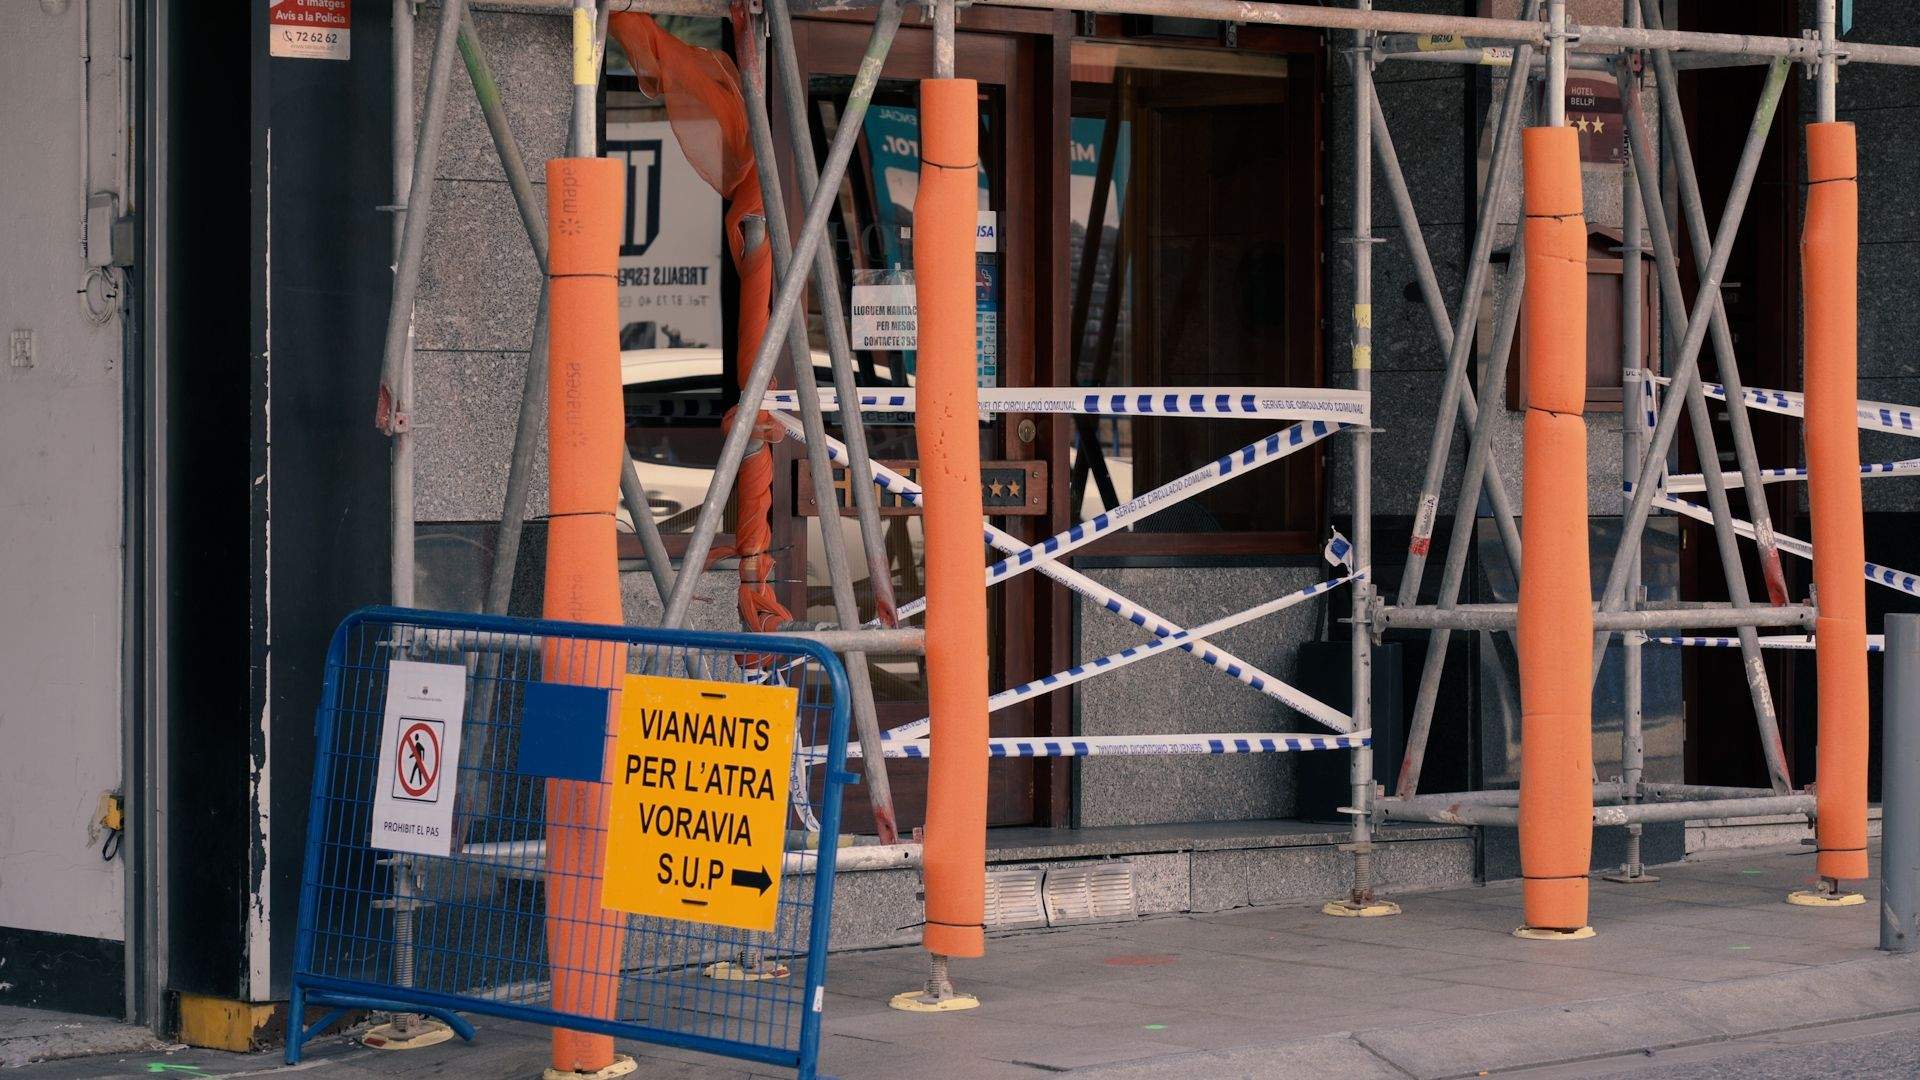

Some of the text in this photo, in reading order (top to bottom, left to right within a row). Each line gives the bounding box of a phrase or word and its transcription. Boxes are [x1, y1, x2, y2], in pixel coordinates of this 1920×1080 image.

[297, 13, 304, 21] a
[305, 11, 314, 22] la
[296, 31, 338, 44] 72 62 62
[1571, 87, 1594, 96] HOTEL
[977, 225, 995, 238] ISA
[853, 305, 886, 316] LLOGUEM
[876, 321, 916, 331] PER MESOS
[864, 336, 900, 346] CONTACTE
[1043, 400, 1077, 411] COMUNAL
[1261, 399, 1286, 410] SERVEI
[1286, 400, 1296, 410] DE
[1334, 402, 1364, 414] COMUNAL
[1114, 502, 1137, 519] SERVEI
[1138, 496, 1147, 509] DE
[1184, 469, 1213, 488] COMUNAL
[640, 707, 771, 752] VIANANTS
[1168, 744, 1179, 754] DE
[1180, 743, 1204, 754] SERVEI
[625, 754, 677, 790] PER
[383, 821, 440, 838] PROHIBIT EL PAS
[639, 802, 753, 847] VORAVIA
[656, 852, 724, 891] S.U.P
